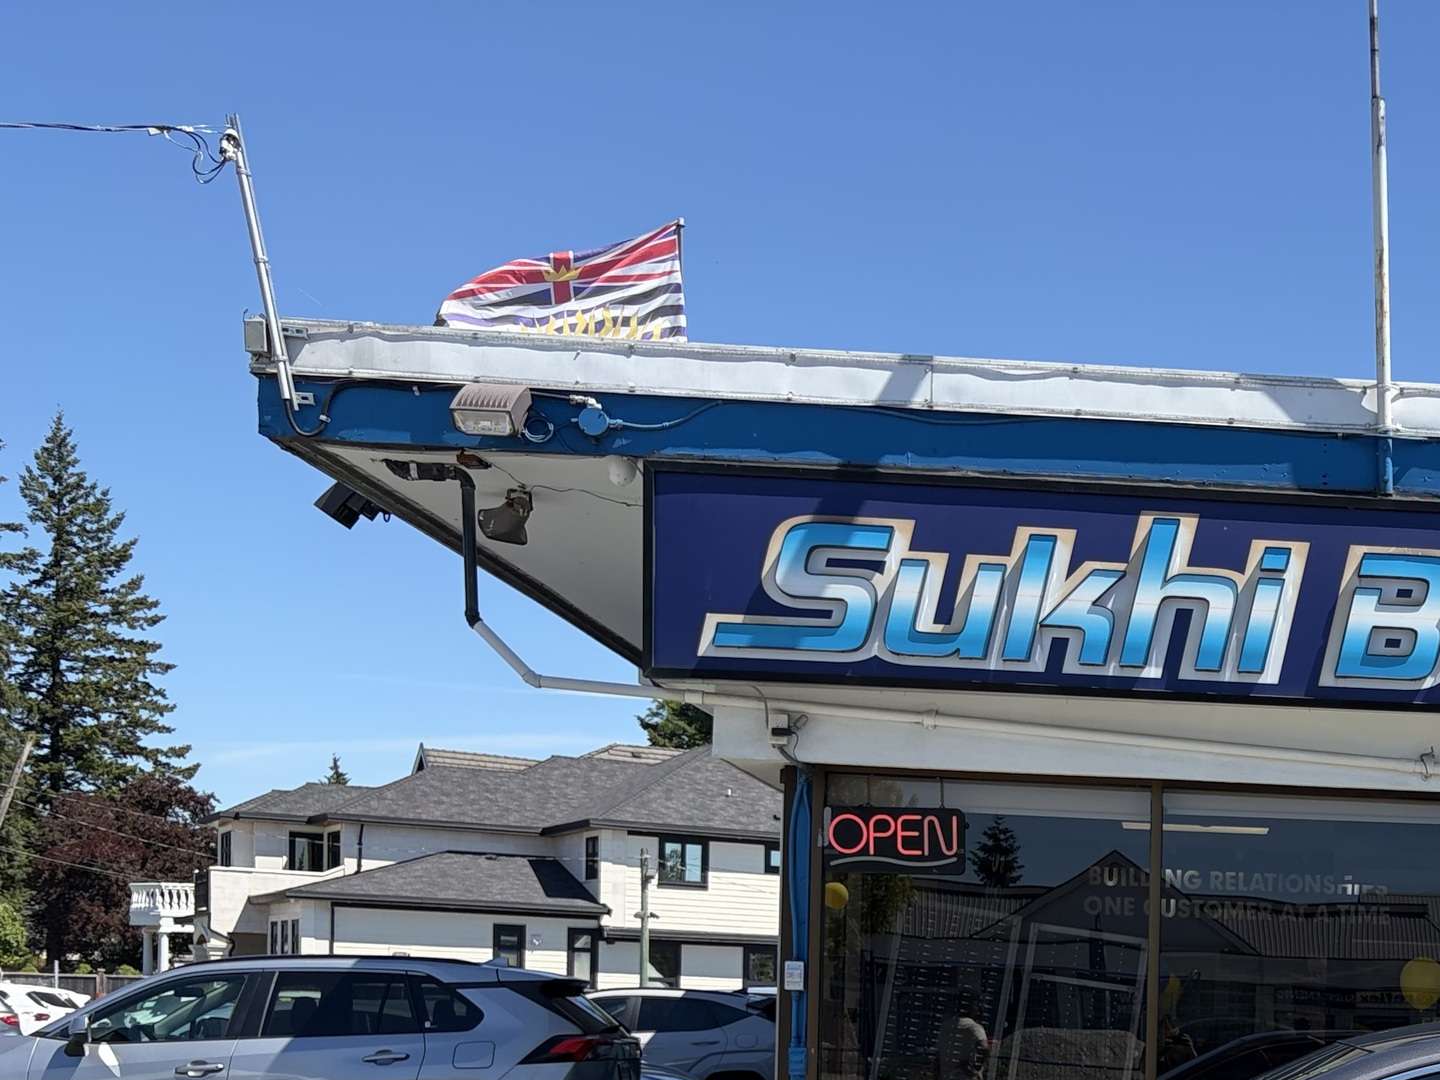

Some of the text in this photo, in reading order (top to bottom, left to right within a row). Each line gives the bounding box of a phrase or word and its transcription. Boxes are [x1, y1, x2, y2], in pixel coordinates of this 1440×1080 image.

[697, 511, 1311, 686] Sukhi
[828, 813, 961, 857] OPEN
[1088, 866, 1202, 890] BUILDNG
[1083, 896, 1136, 917] ONE
